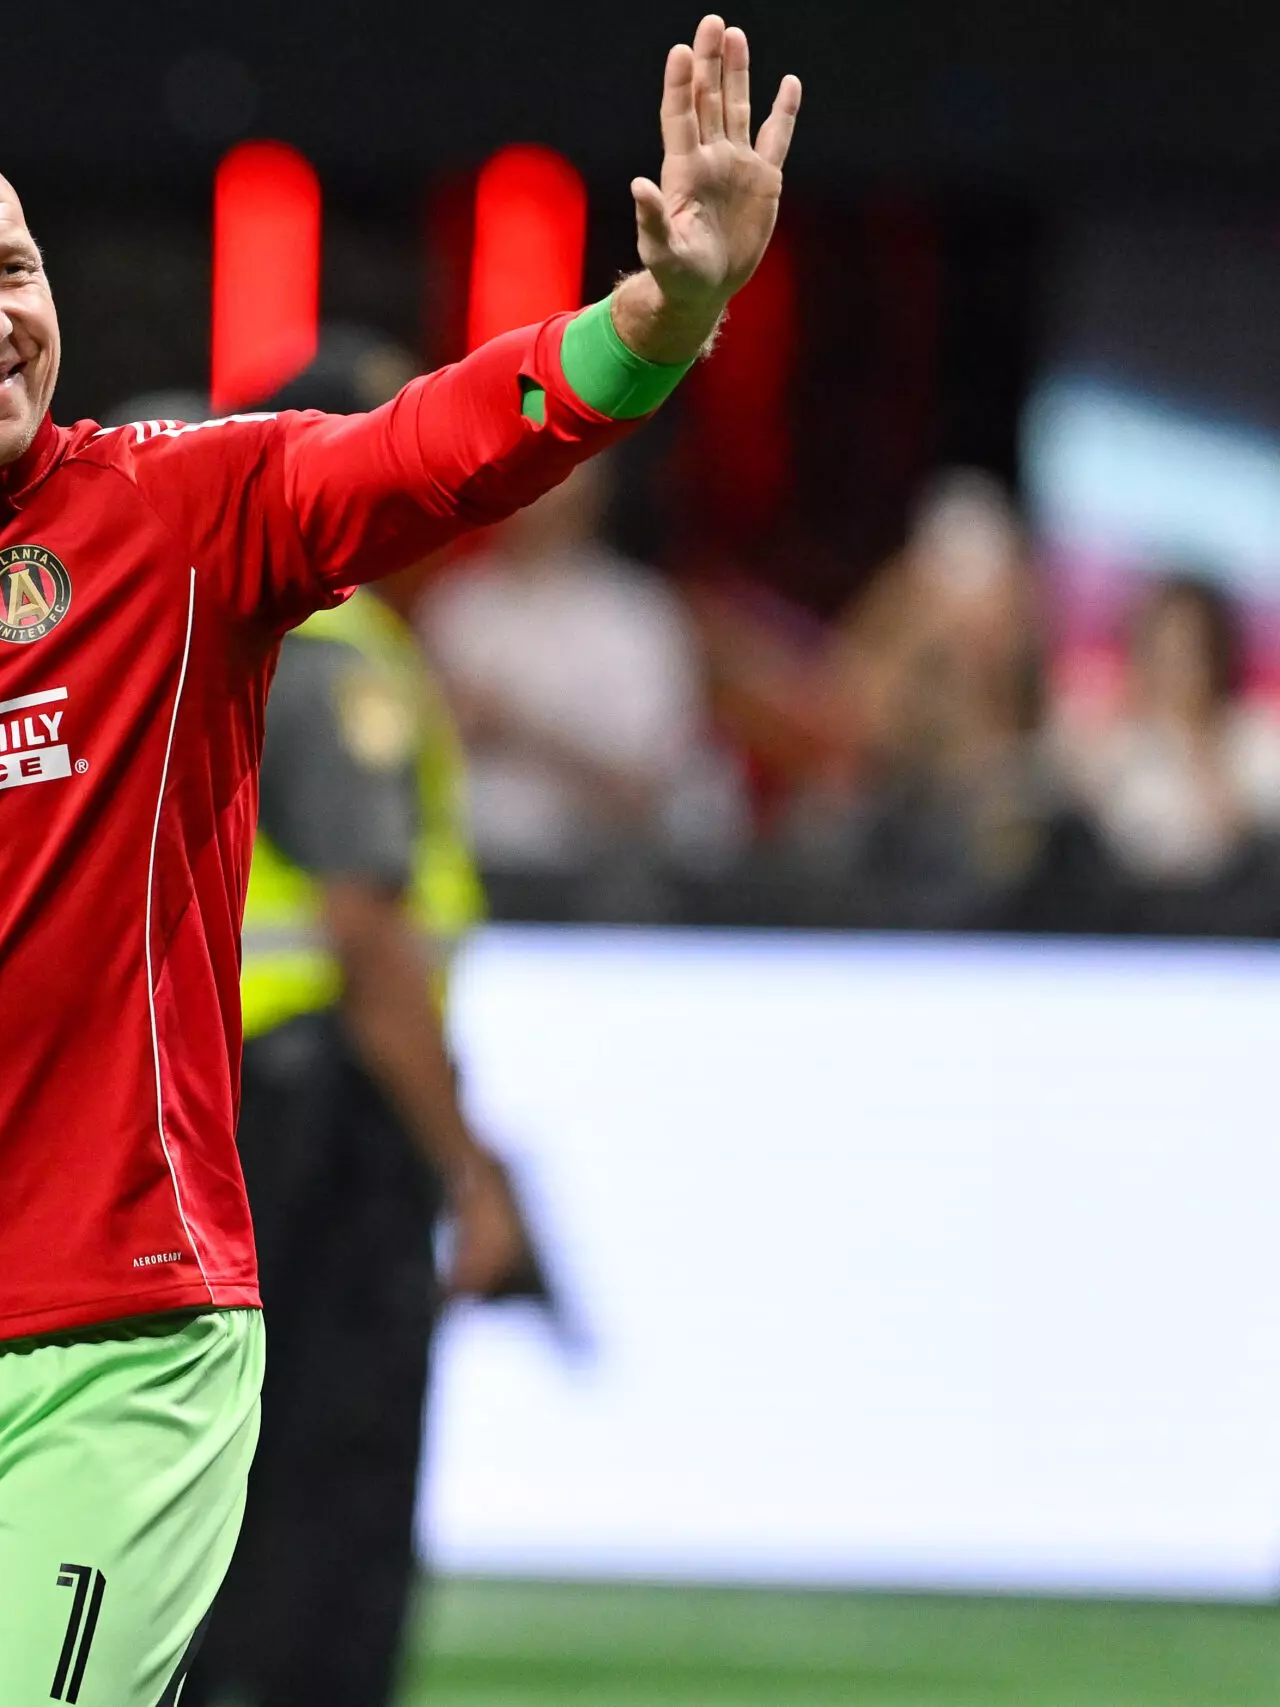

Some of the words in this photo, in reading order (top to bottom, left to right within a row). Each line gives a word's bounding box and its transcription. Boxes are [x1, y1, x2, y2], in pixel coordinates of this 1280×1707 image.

[49, 604, 65, 622] FC
[133, 1252, 182, 1268] AEROREADY
[50, 1563, 107, 1705] 1
